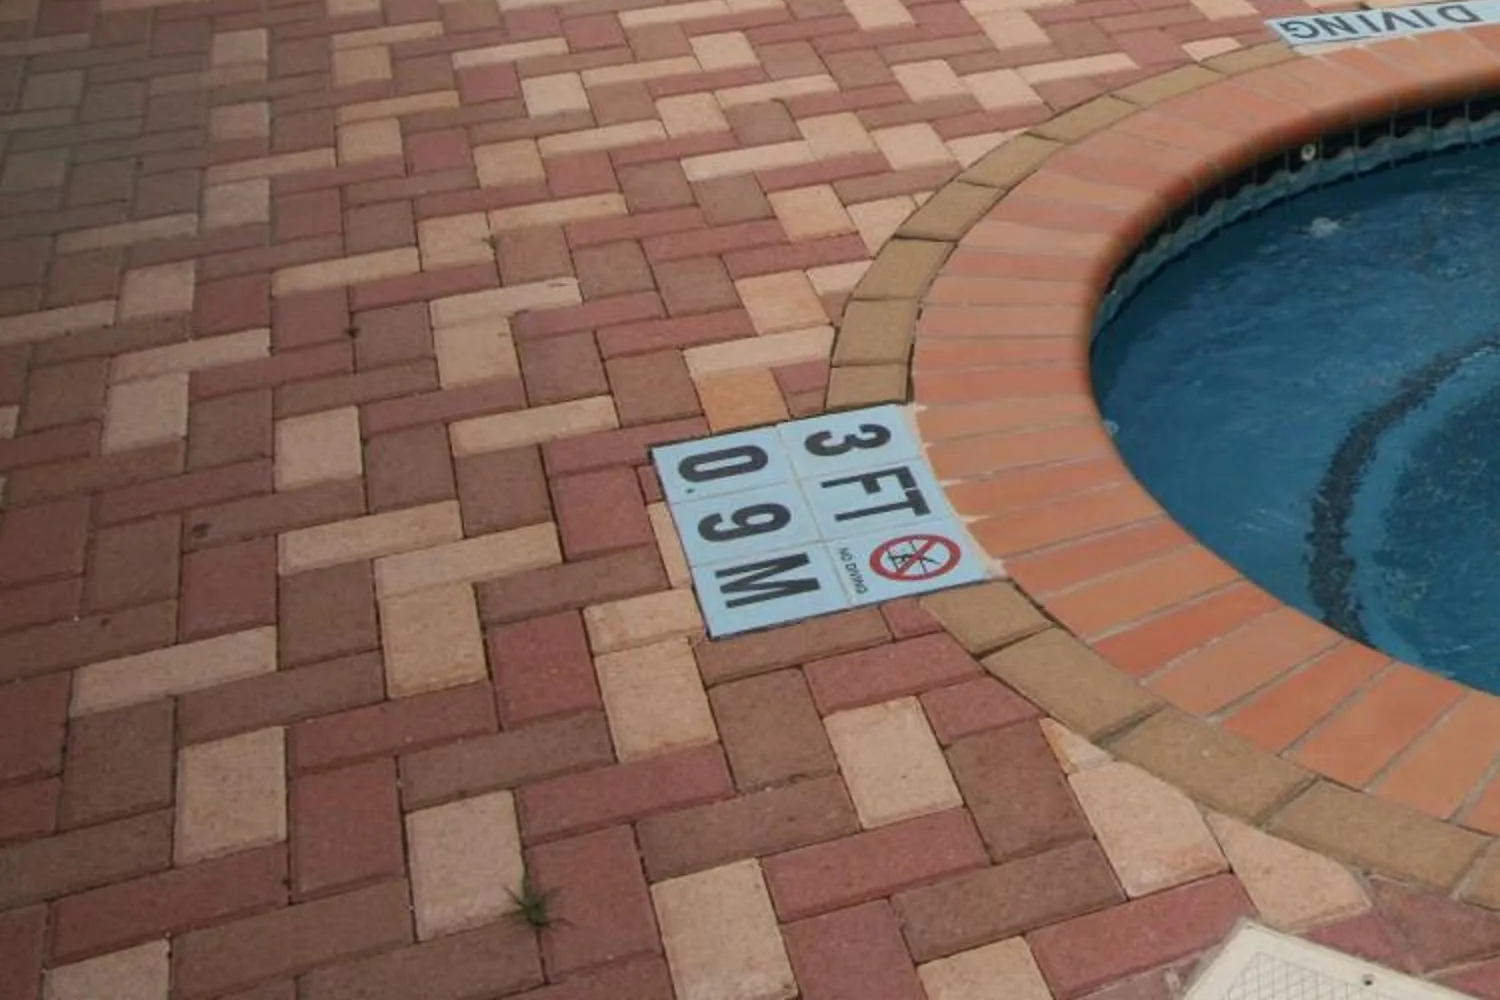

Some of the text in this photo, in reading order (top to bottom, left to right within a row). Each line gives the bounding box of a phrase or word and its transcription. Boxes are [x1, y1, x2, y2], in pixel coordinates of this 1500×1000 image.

[1280, 4, 1481, 40] DIVING
[804, 423, 931, 522] 3 FT
[715, 552, 821, 609] M
